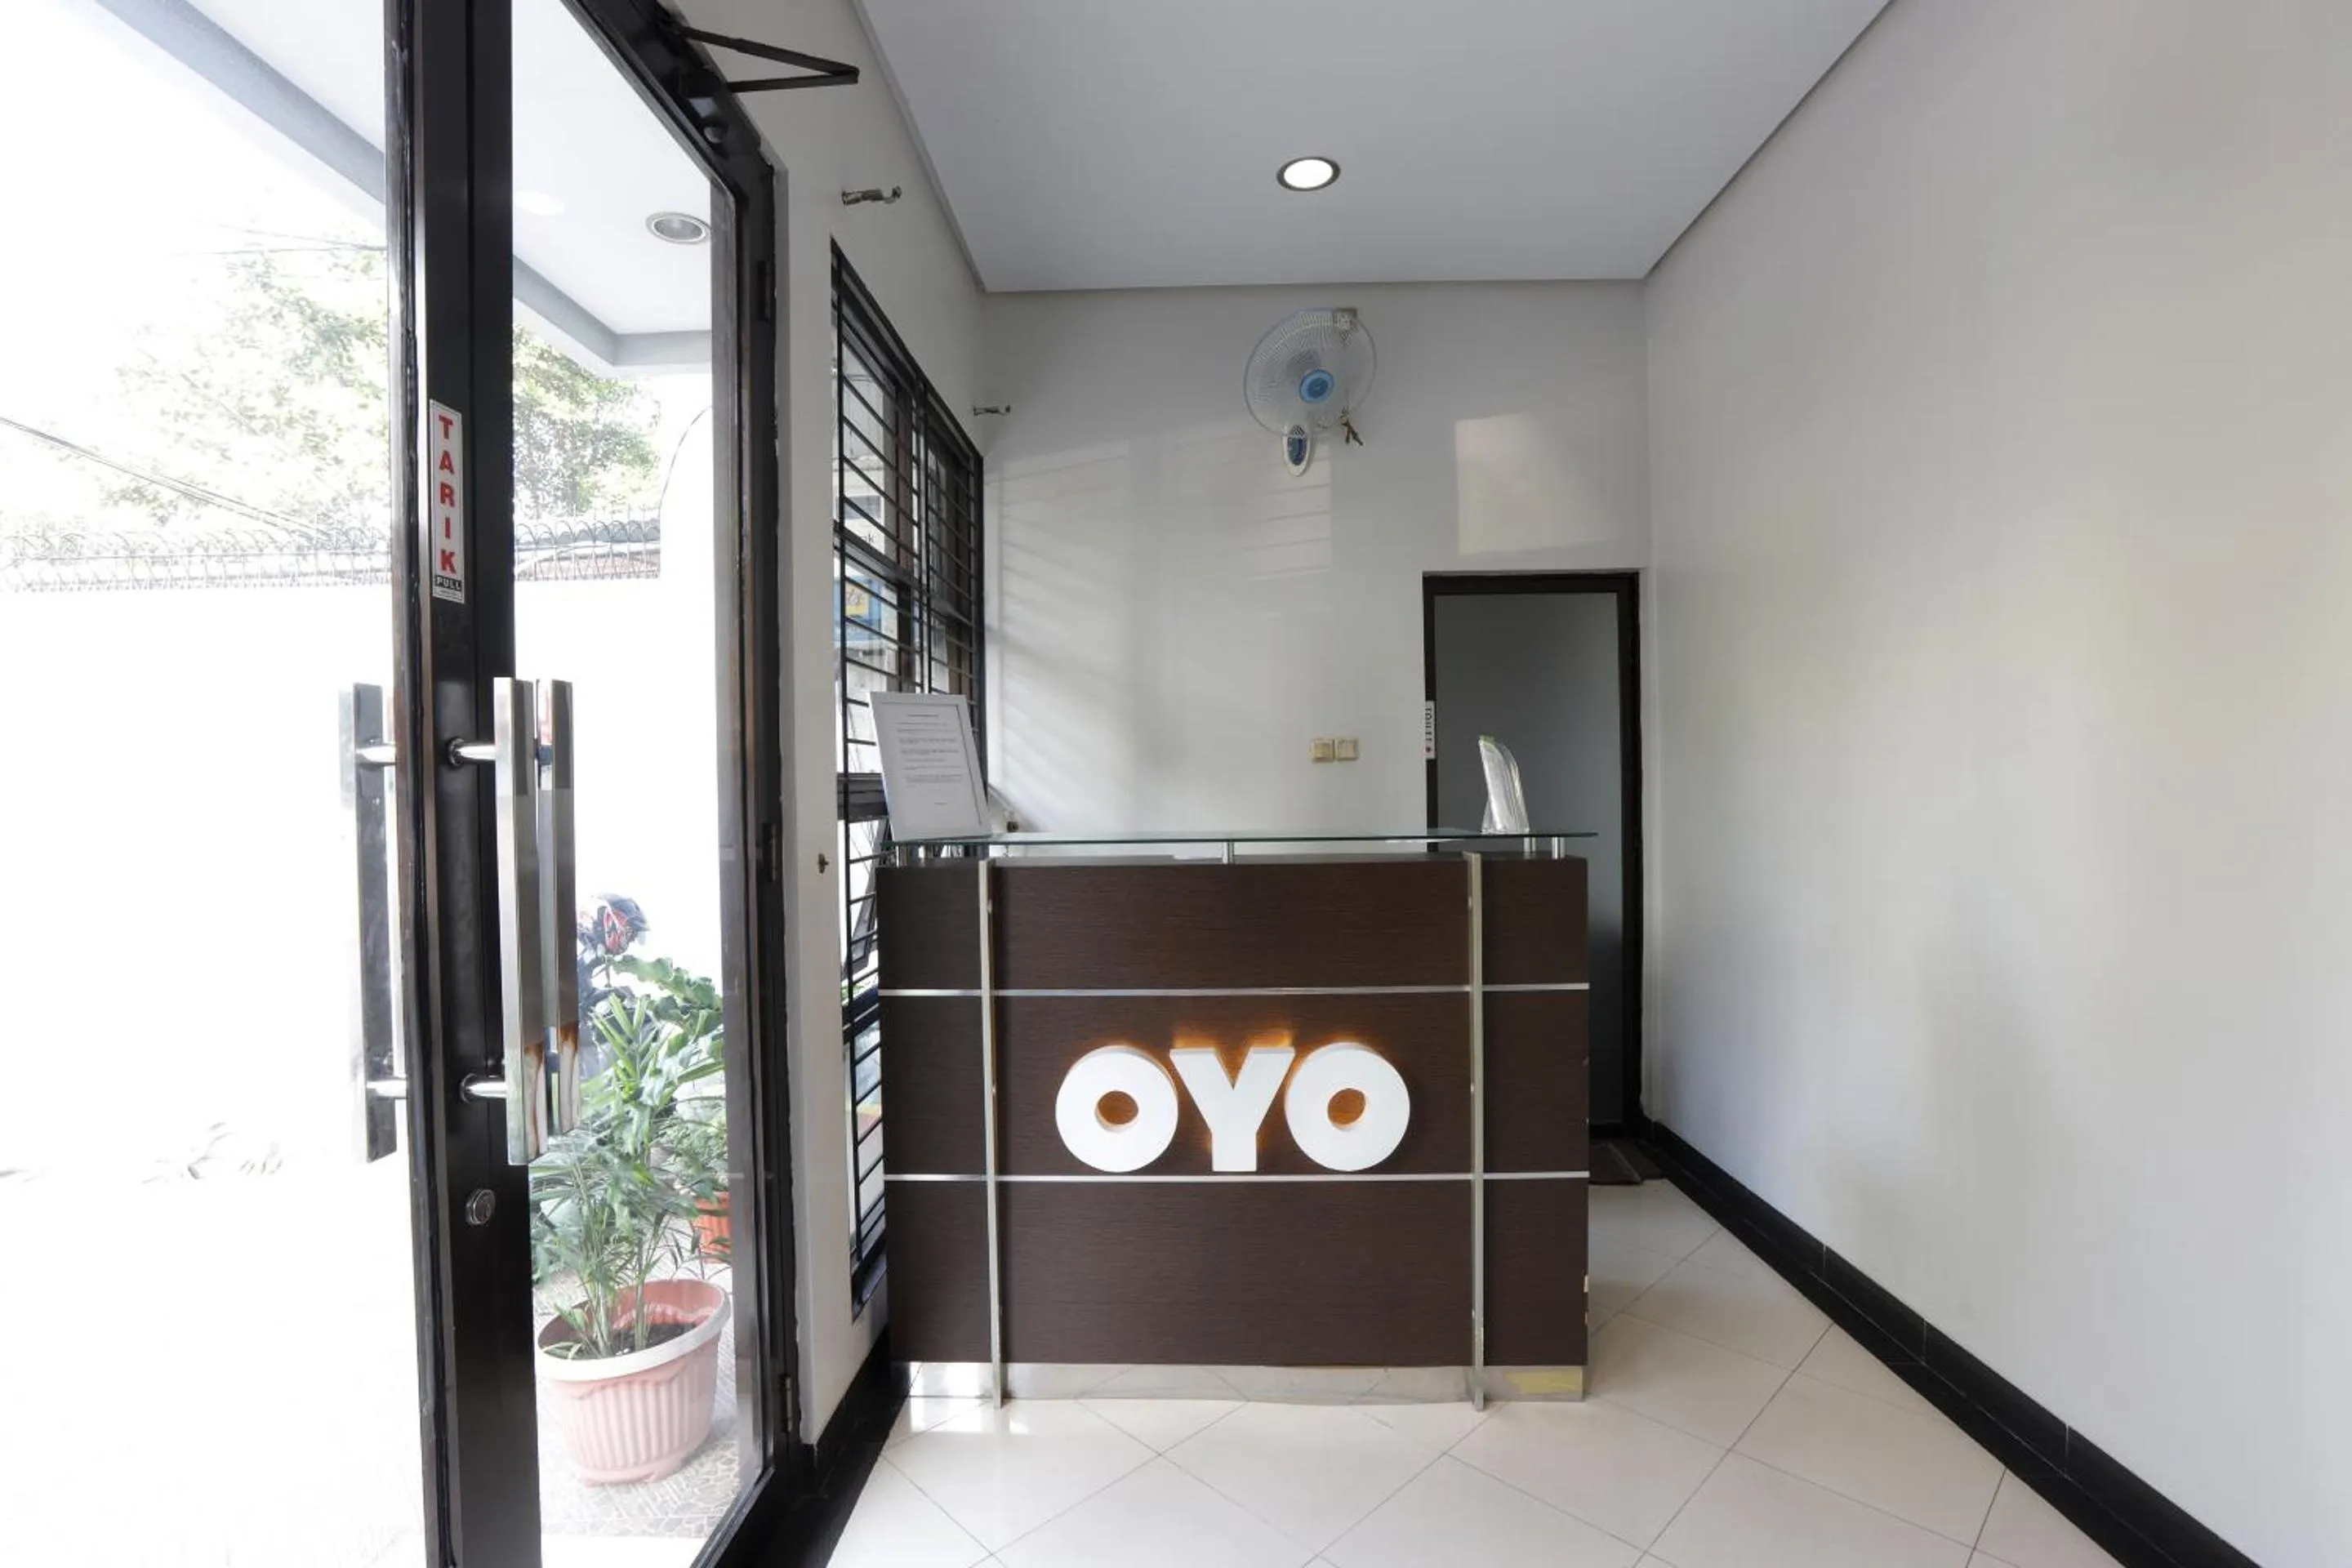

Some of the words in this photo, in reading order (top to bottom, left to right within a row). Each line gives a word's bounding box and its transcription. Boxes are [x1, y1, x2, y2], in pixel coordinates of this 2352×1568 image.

[439, 415, 457, 573] TARIK
[436, 576, 461, 590] PULL
[1055, 1042, 1410, 1172] OYO
